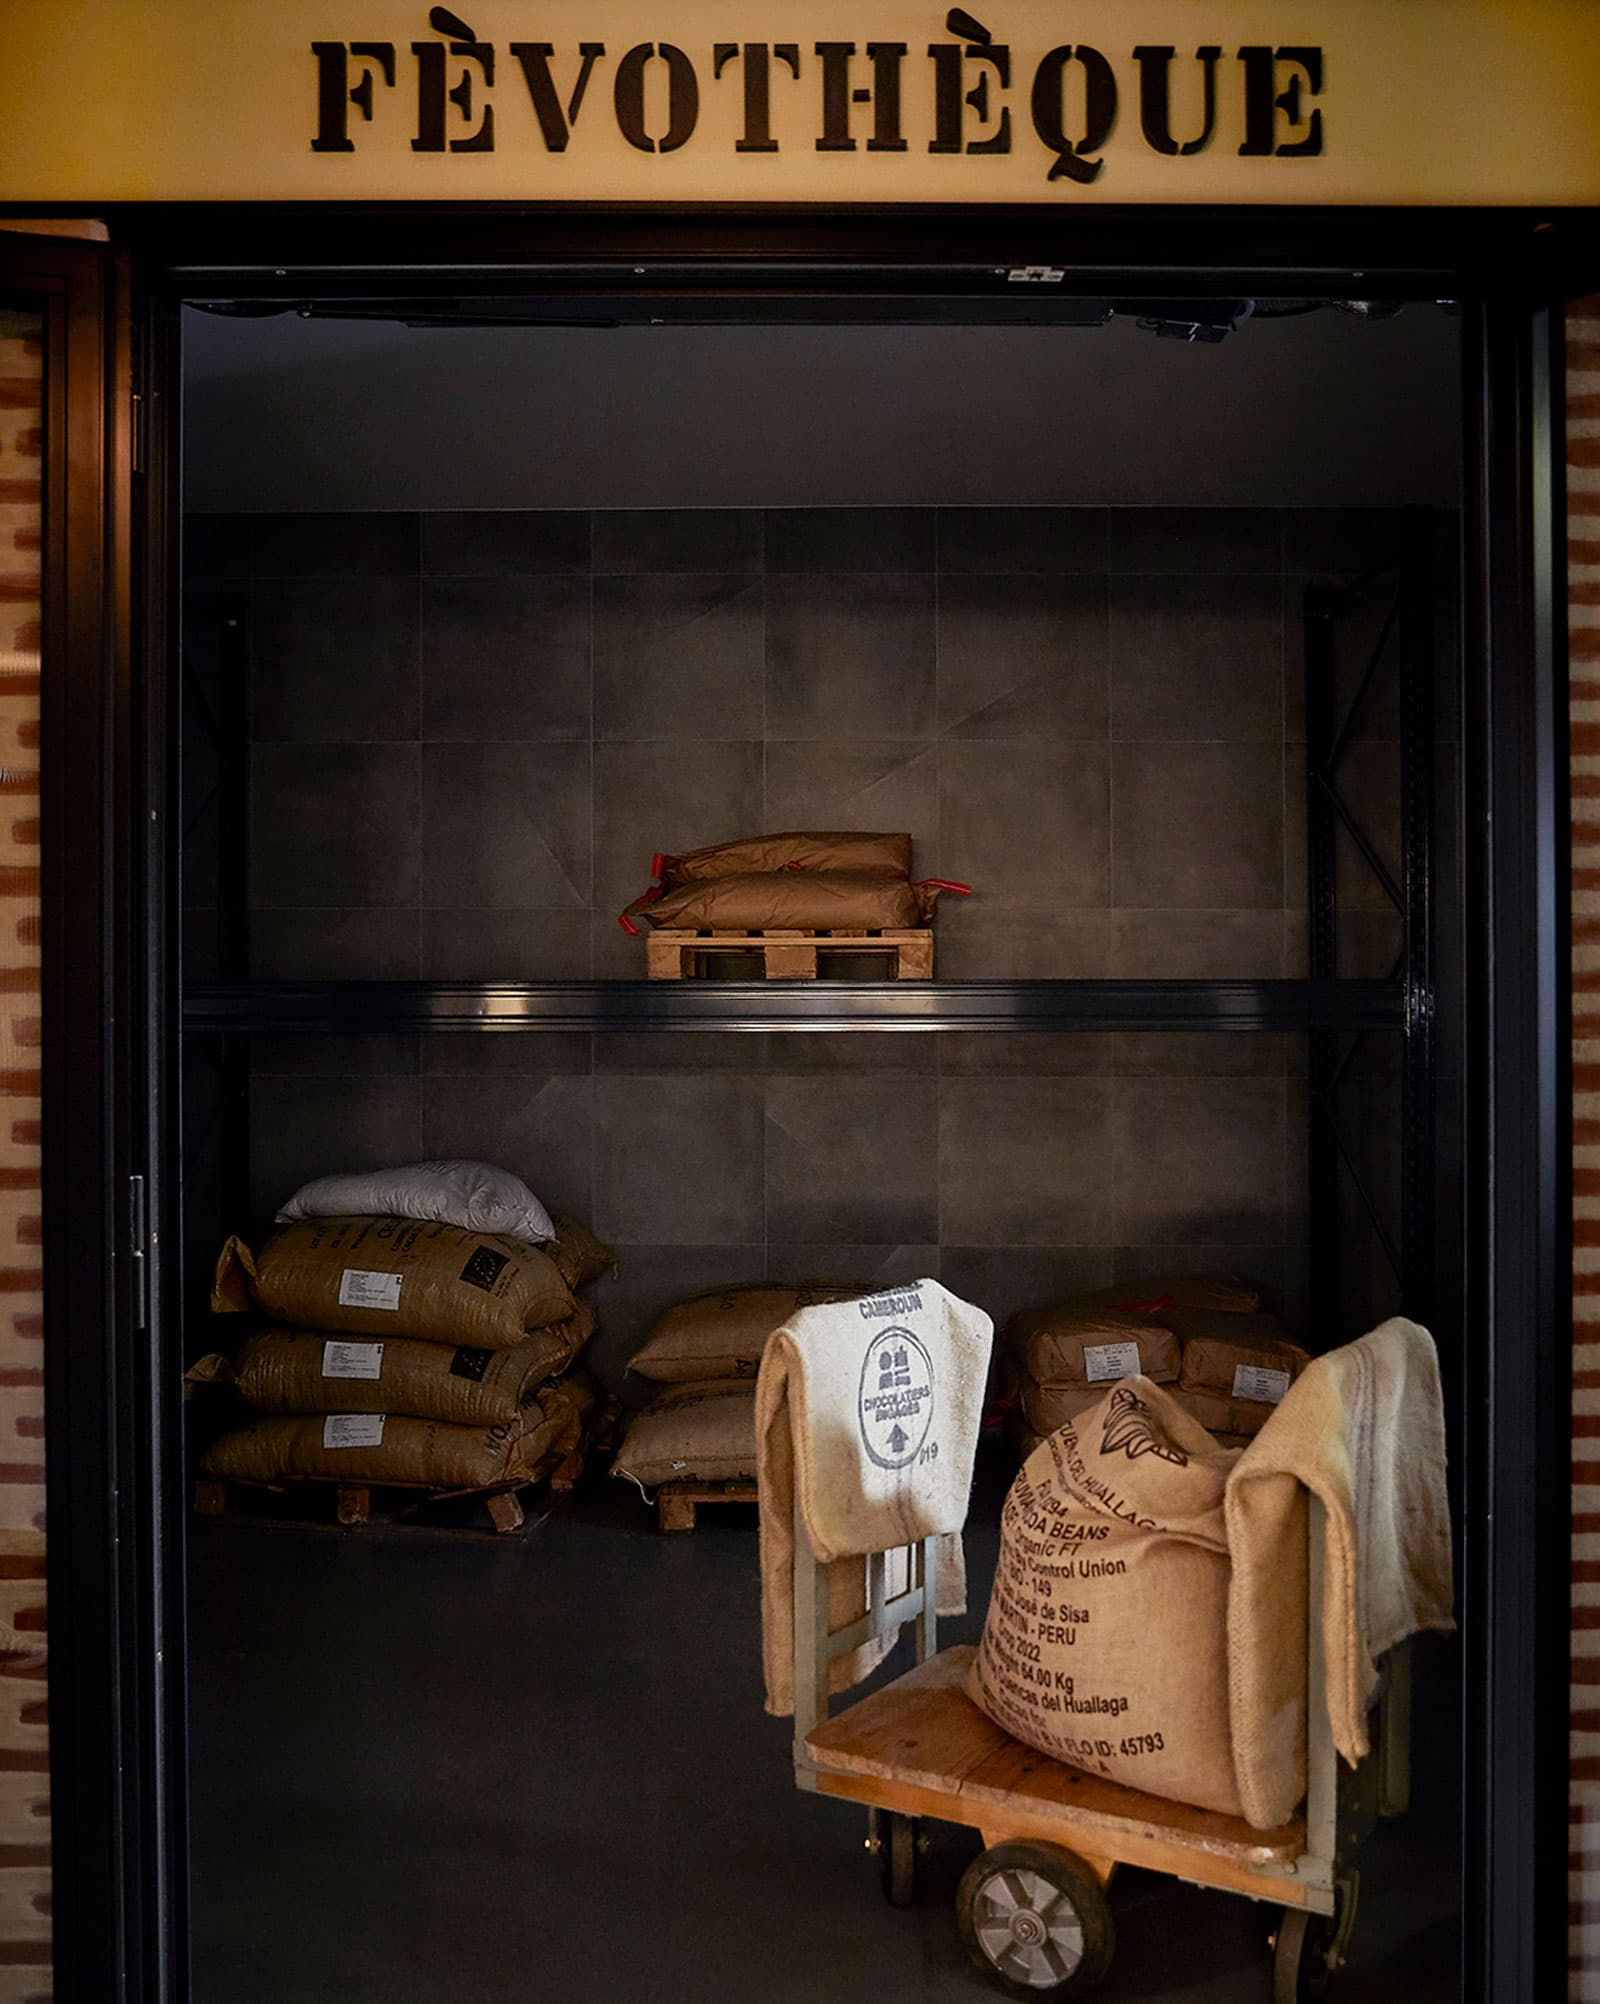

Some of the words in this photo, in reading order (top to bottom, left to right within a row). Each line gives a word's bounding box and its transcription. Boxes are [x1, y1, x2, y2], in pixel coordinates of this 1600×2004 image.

[311, 7, 1324, 184] FÈVOTHÈQUE
[859, 1292, 923, 1320] CAMEROUN
[1049, 1519, 1111, 1540] BEANS
[1059, 1541, 1083, 1556] FT
[1028, 1557, 1075, 1579] Control
[1078, 1558, 1127, 1579] Union
[1032, 1577, 1053, 1598] 149
[1040, 1601, 1056, 1621] de
[1059, 1604, 1090, 1624] Sisa
[1038, 1622, 1076, 1646] PERU
[1016, 1636, 1042, 1662] 2022
[1054, 1672, 1075, 1695] Kg
[1041, 1693, 1062, 1713] del
[1064, 1695, 1129, 1717] Huallaga
[1095, 1740, 1118, 1758] ID:
[1119, 1731, 1166, 1758] 45793
